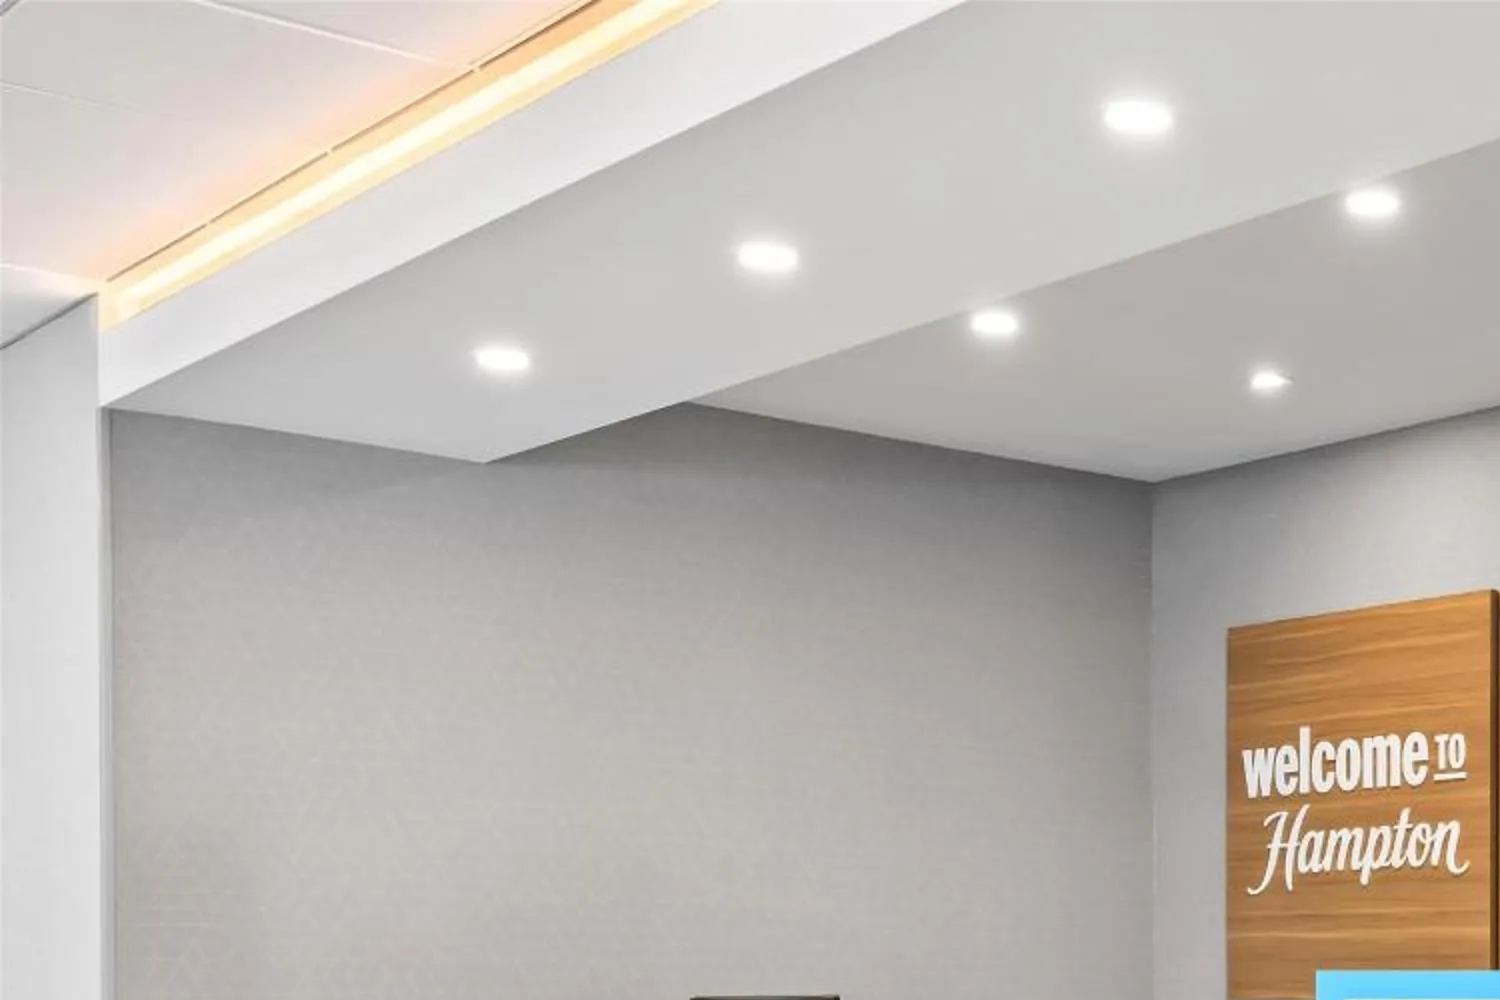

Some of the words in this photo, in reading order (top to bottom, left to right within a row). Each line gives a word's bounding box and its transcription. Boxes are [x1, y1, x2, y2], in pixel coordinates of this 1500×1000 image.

[1242, 725, 1429, 799] welcome
[1434, 732, 1466, 769] TO
[1247, 804, 1470, 895] Hampton
